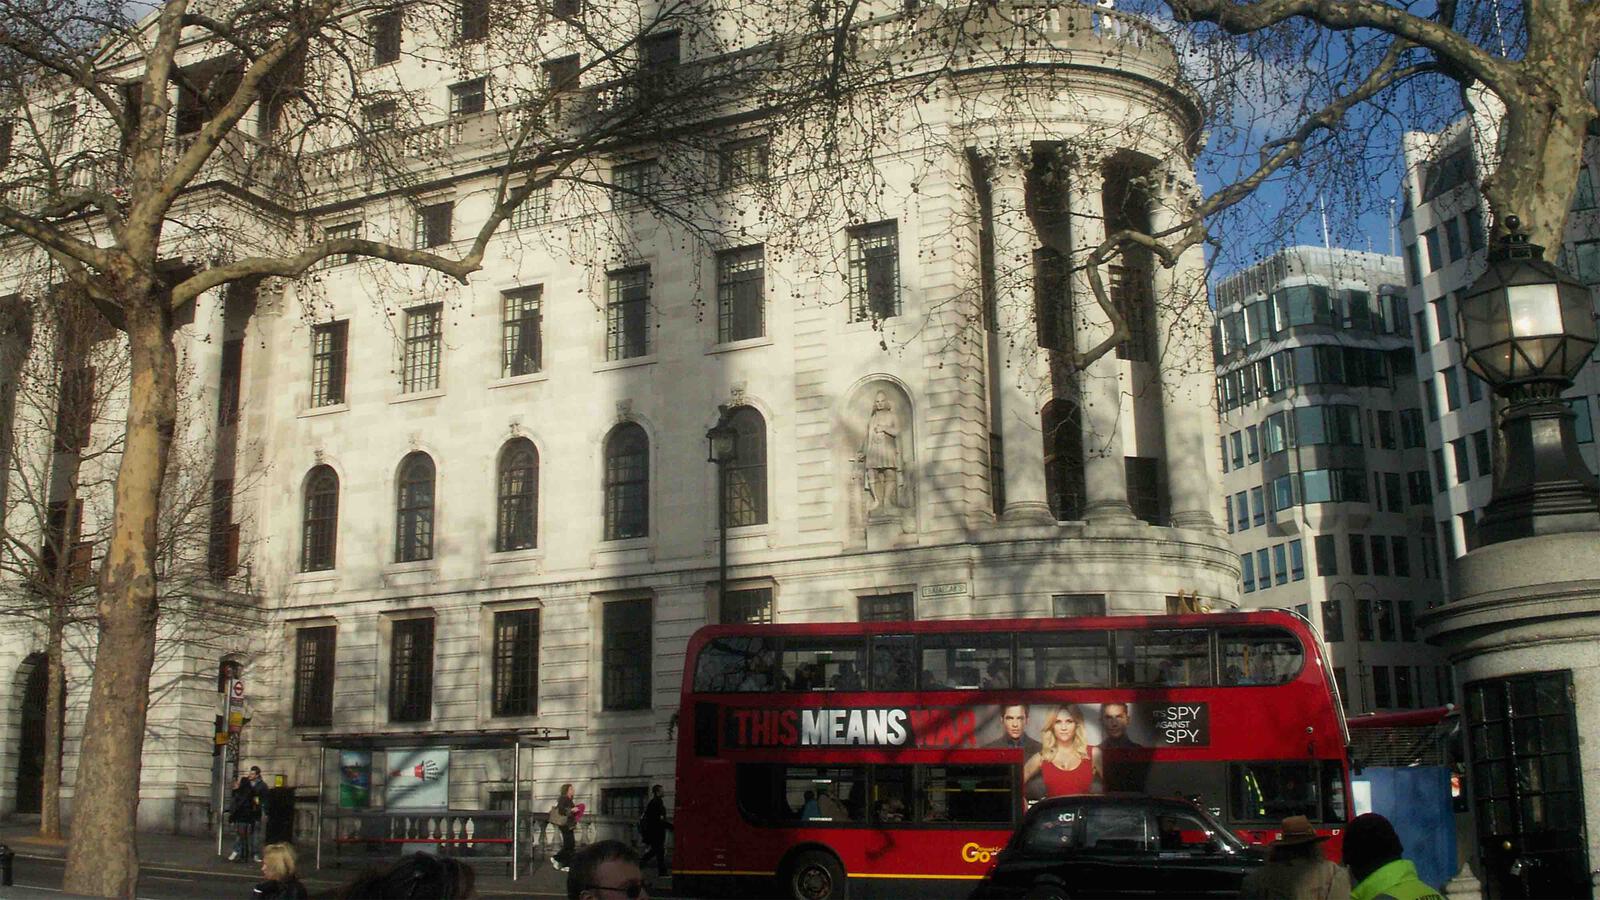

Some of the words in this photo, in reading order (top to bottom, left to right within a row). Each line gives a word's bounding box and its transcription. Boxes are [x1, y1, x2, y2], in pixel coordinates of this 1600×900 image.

[1167, 706, 1201, 720] SPY
[735, 709, 799, 744] THIS
[801, 708, 907, 745] MEANS
[910, 709, 977, 745] WAR
[1155, 720, 1191, 728] AGAINST
[1165, 729, 1199, 743] SPY.
[962, 842, 990, 863] Go
